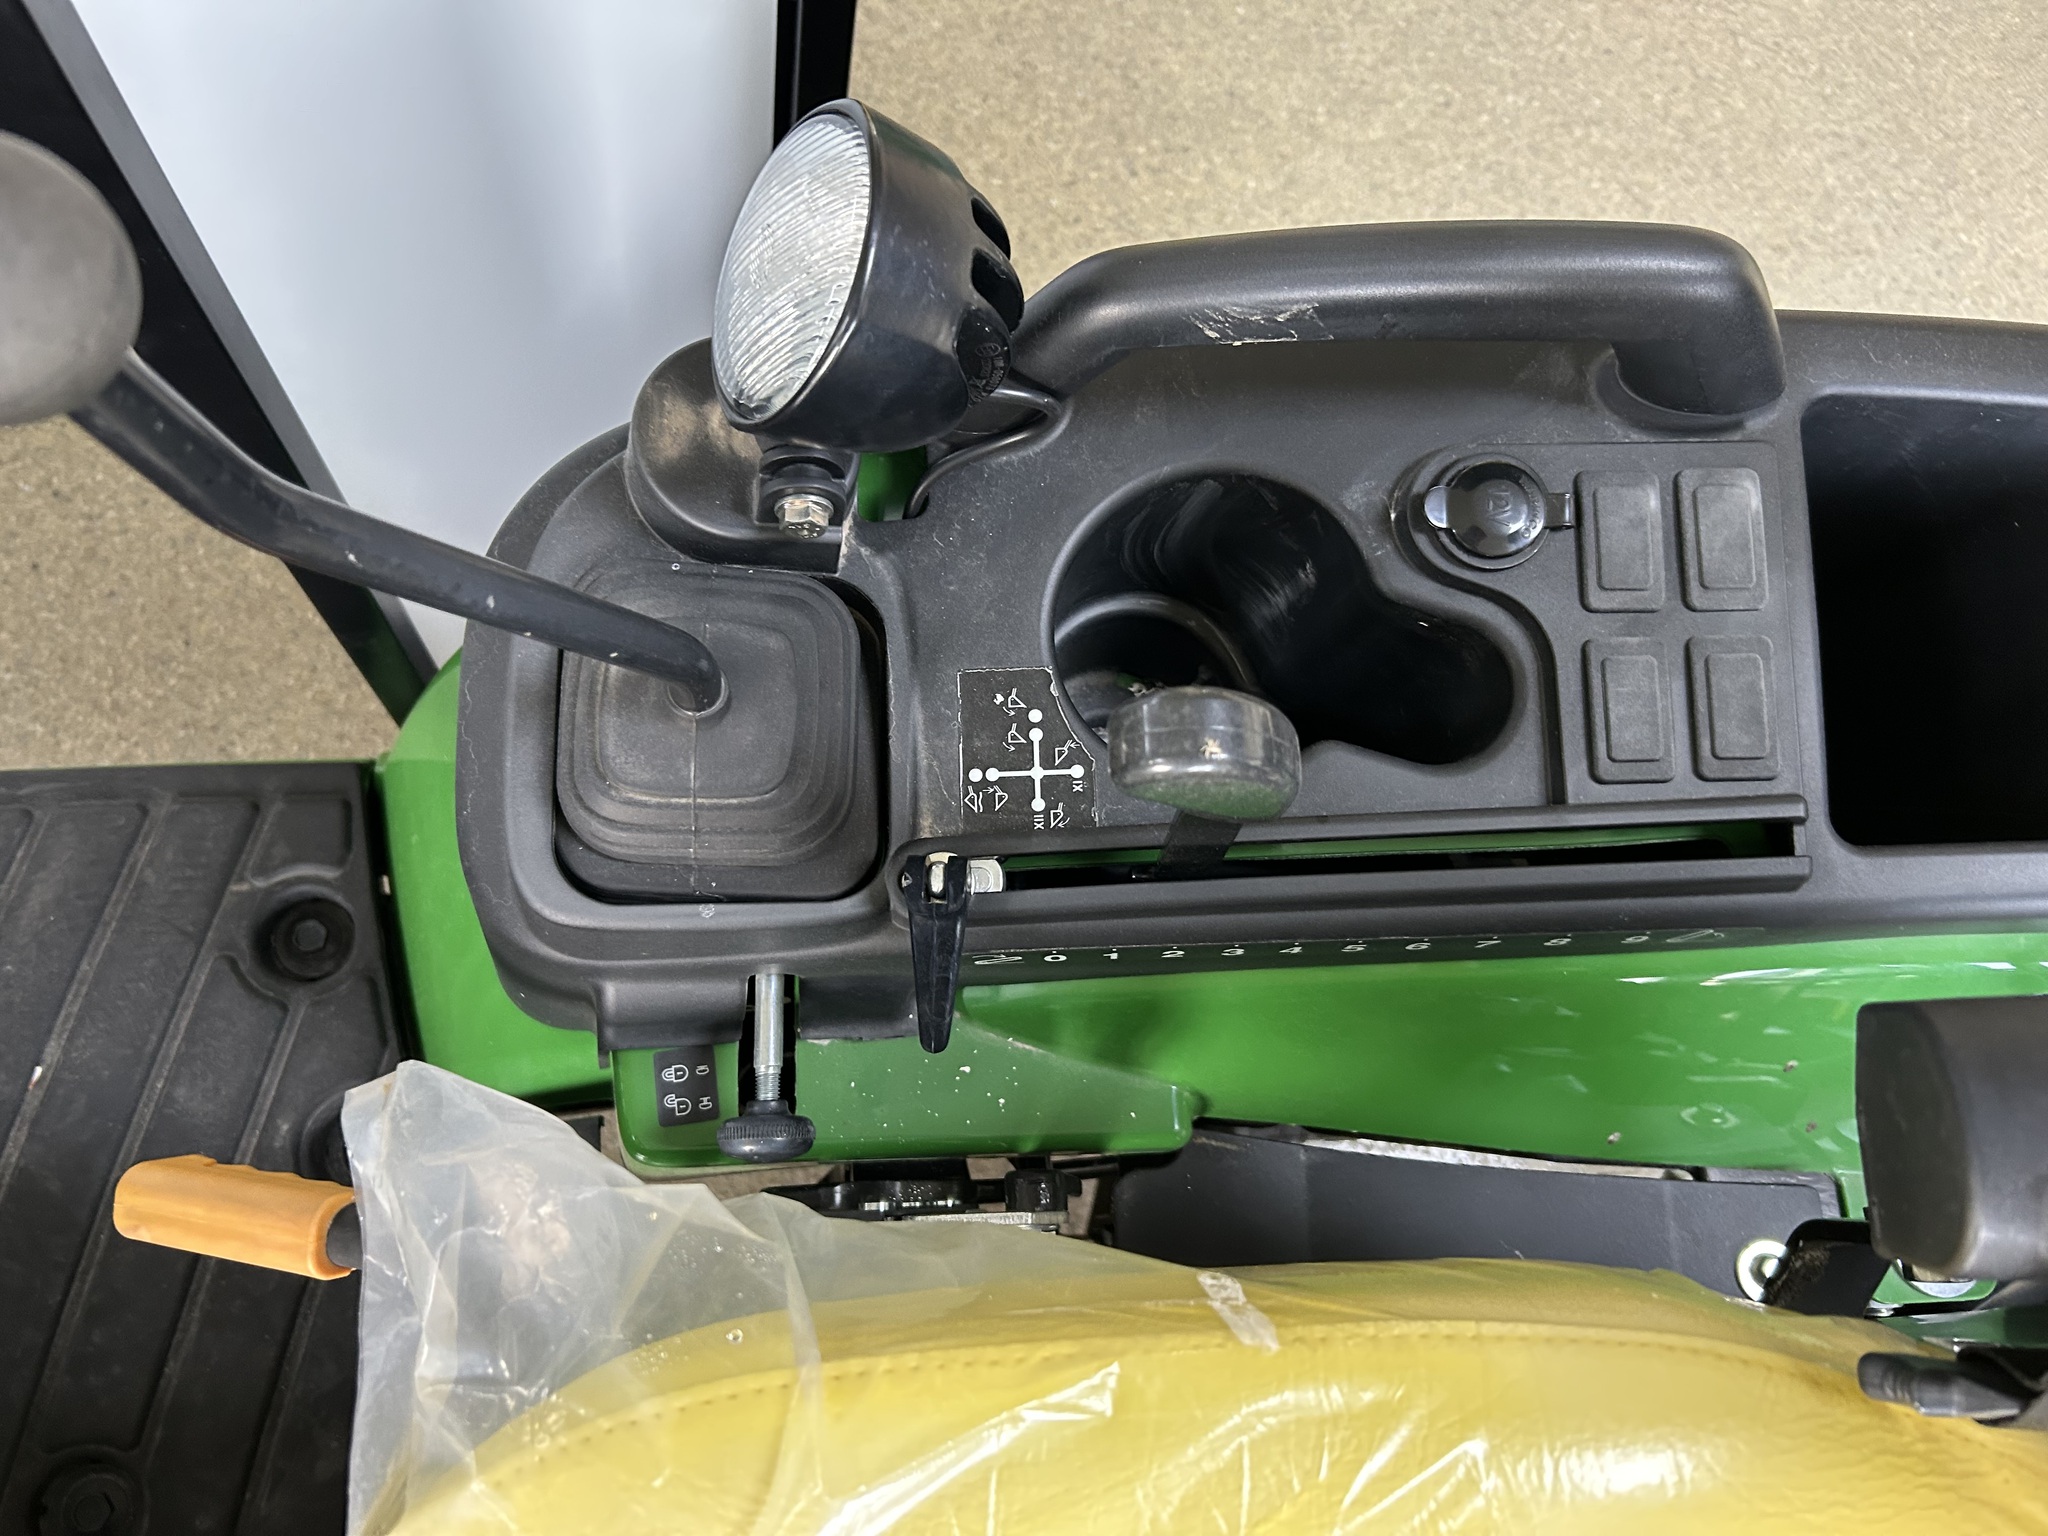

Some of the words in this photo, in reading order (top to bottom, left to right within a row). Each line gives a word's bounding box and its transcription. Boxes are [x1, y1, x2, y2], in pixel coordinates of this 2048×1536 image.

[1487, 490, 1512, 527] 12V
[1043, 954, 1068, 962] 0
[1103, 952, 1119, 960] 1
[1161, 950, 1185, 958] 2
[1221, 948, 1245, 956] 3
[1279, 946, 1302, 954] 4
[1341, 944, 1367, 952] 5
[1405, 942, 1431, 951] 6
[1474, 940, 1502, 948] 7
[1543, 937, 1572, 946] 8
[1620, 935, 1649, 944] 9
